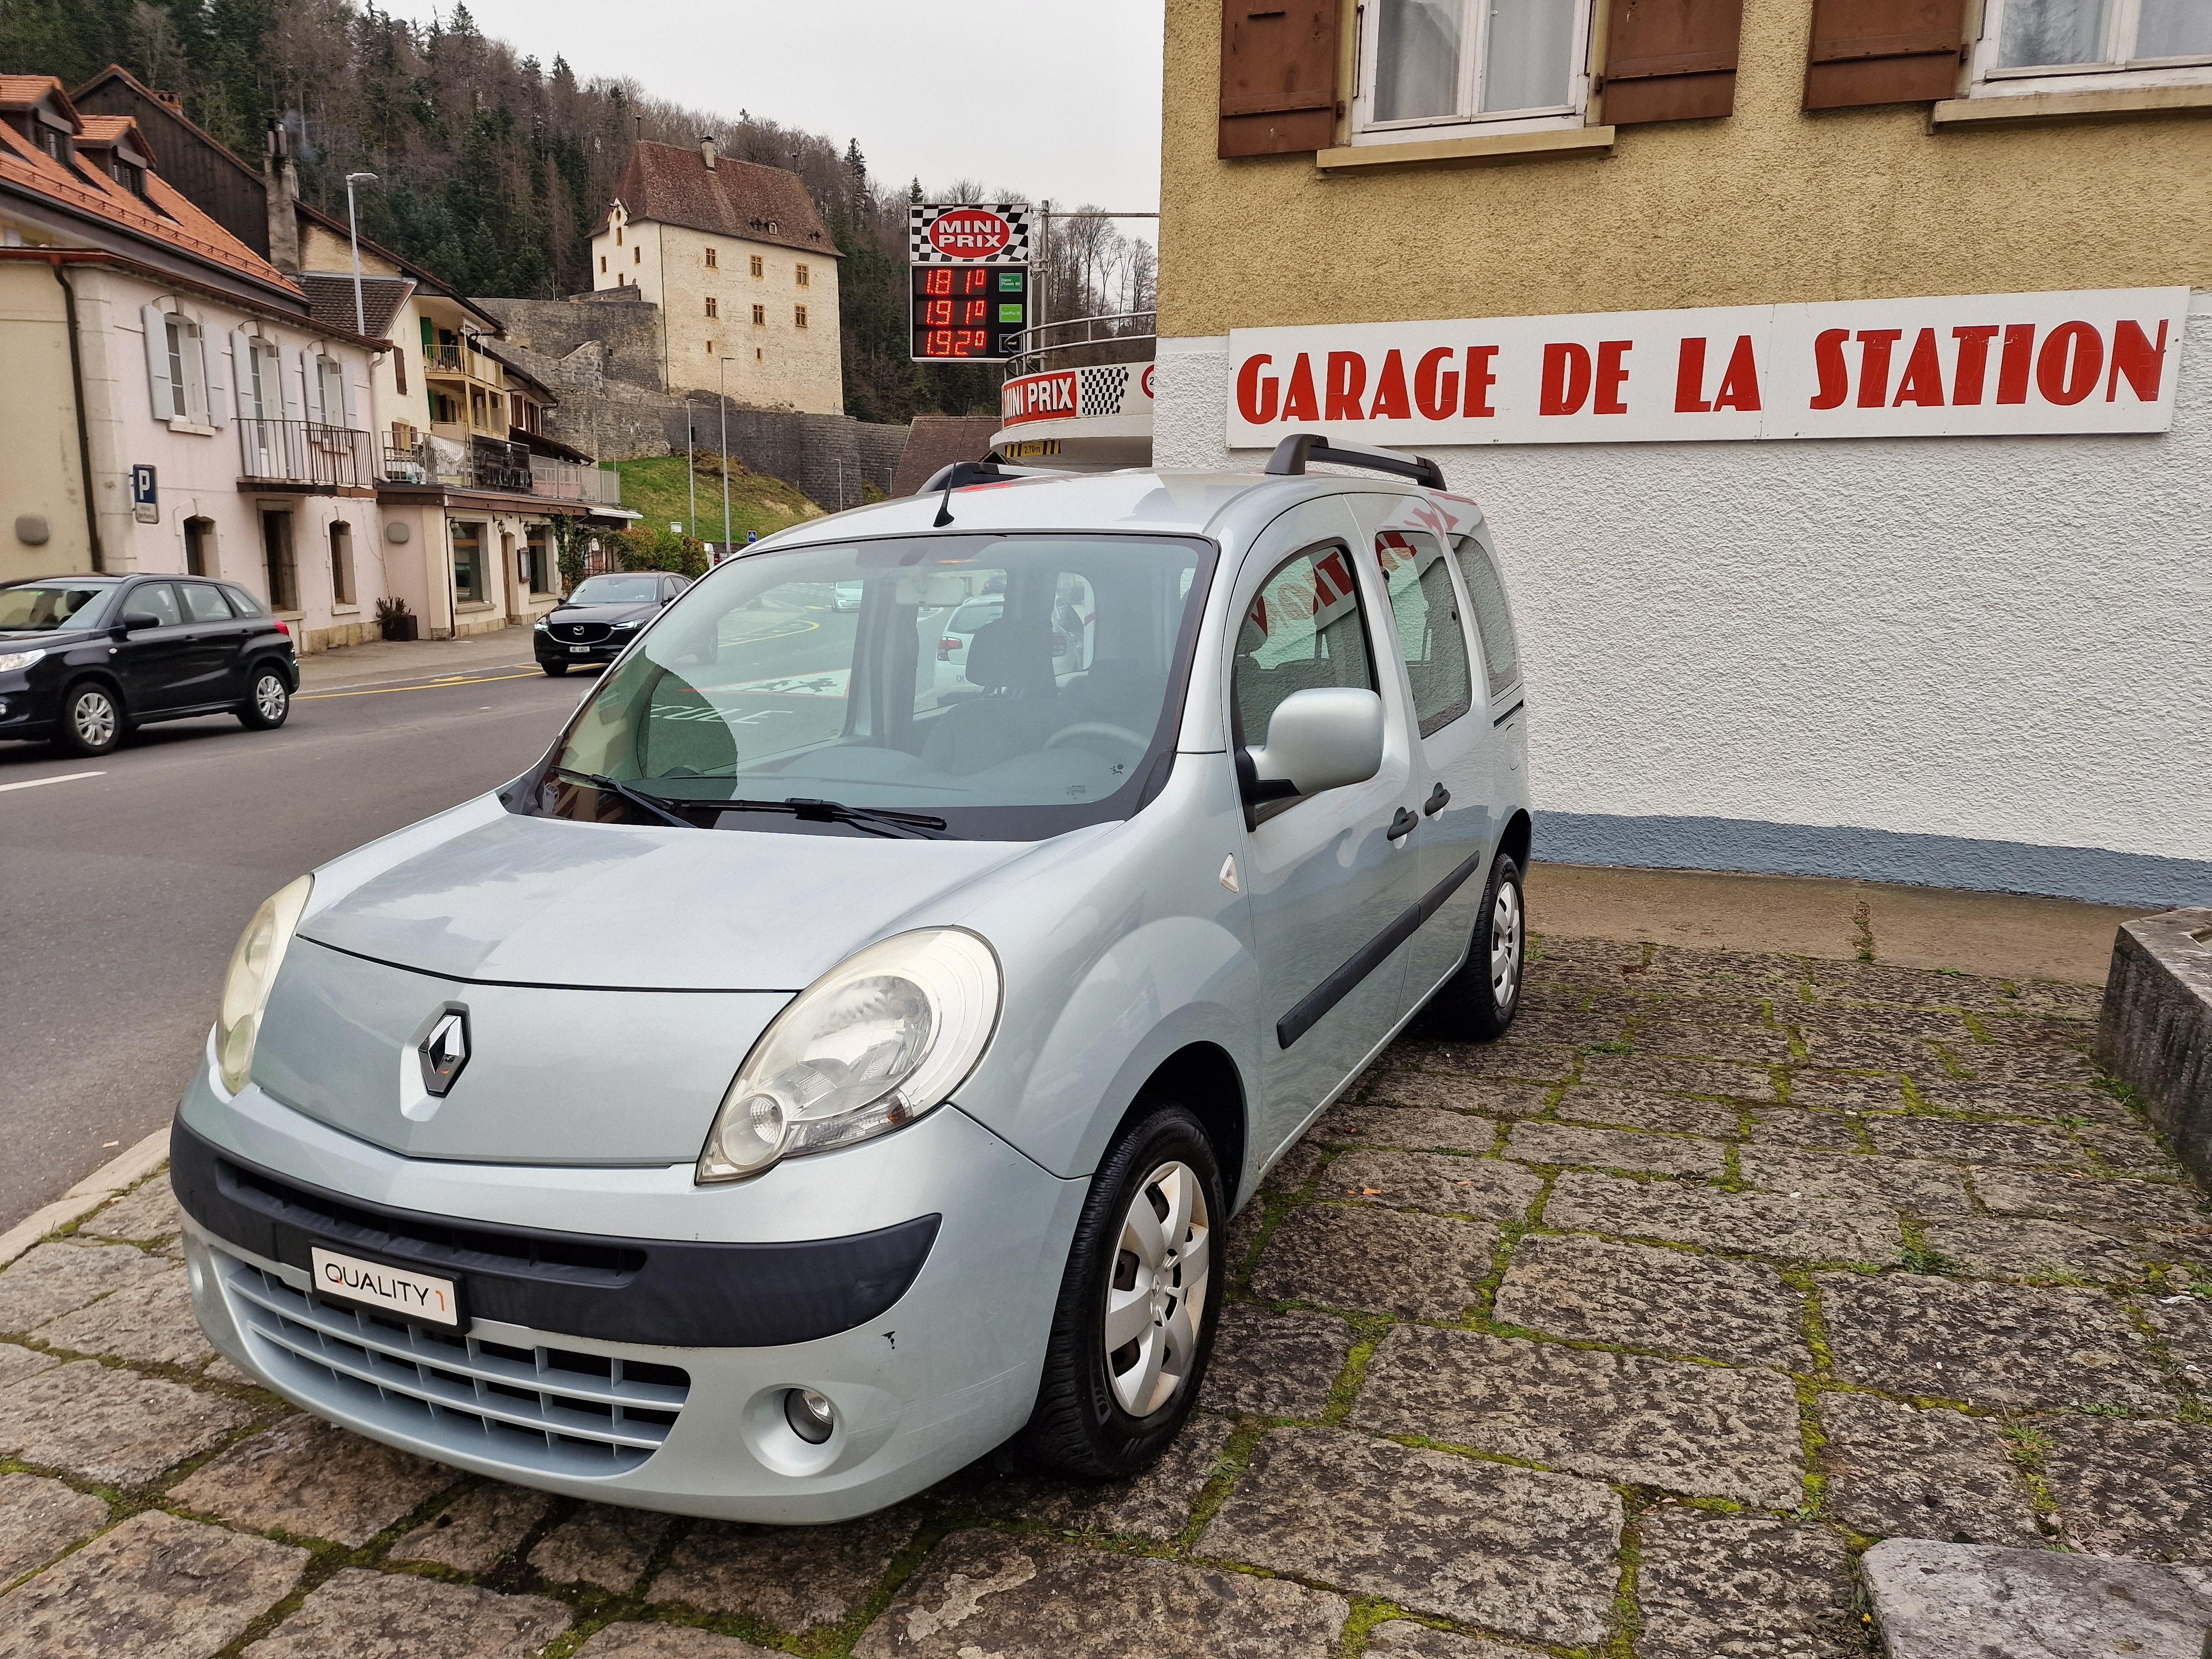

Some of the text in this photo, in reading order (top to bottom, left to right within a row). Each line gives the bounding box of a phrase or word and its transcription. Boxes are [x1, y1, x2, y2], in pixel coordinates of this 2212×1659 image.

[938, 220, 1000, 233] MINI
[938, 234, 1001, 248] PRIX
[1237, 319, 2169, 424] GARAGE DE LA STATION
[1004, 377, 1074, 419] MINI PRIX
[138, 469, 150, 500] P
[325, 1262, 429, 1306] QUALITY
